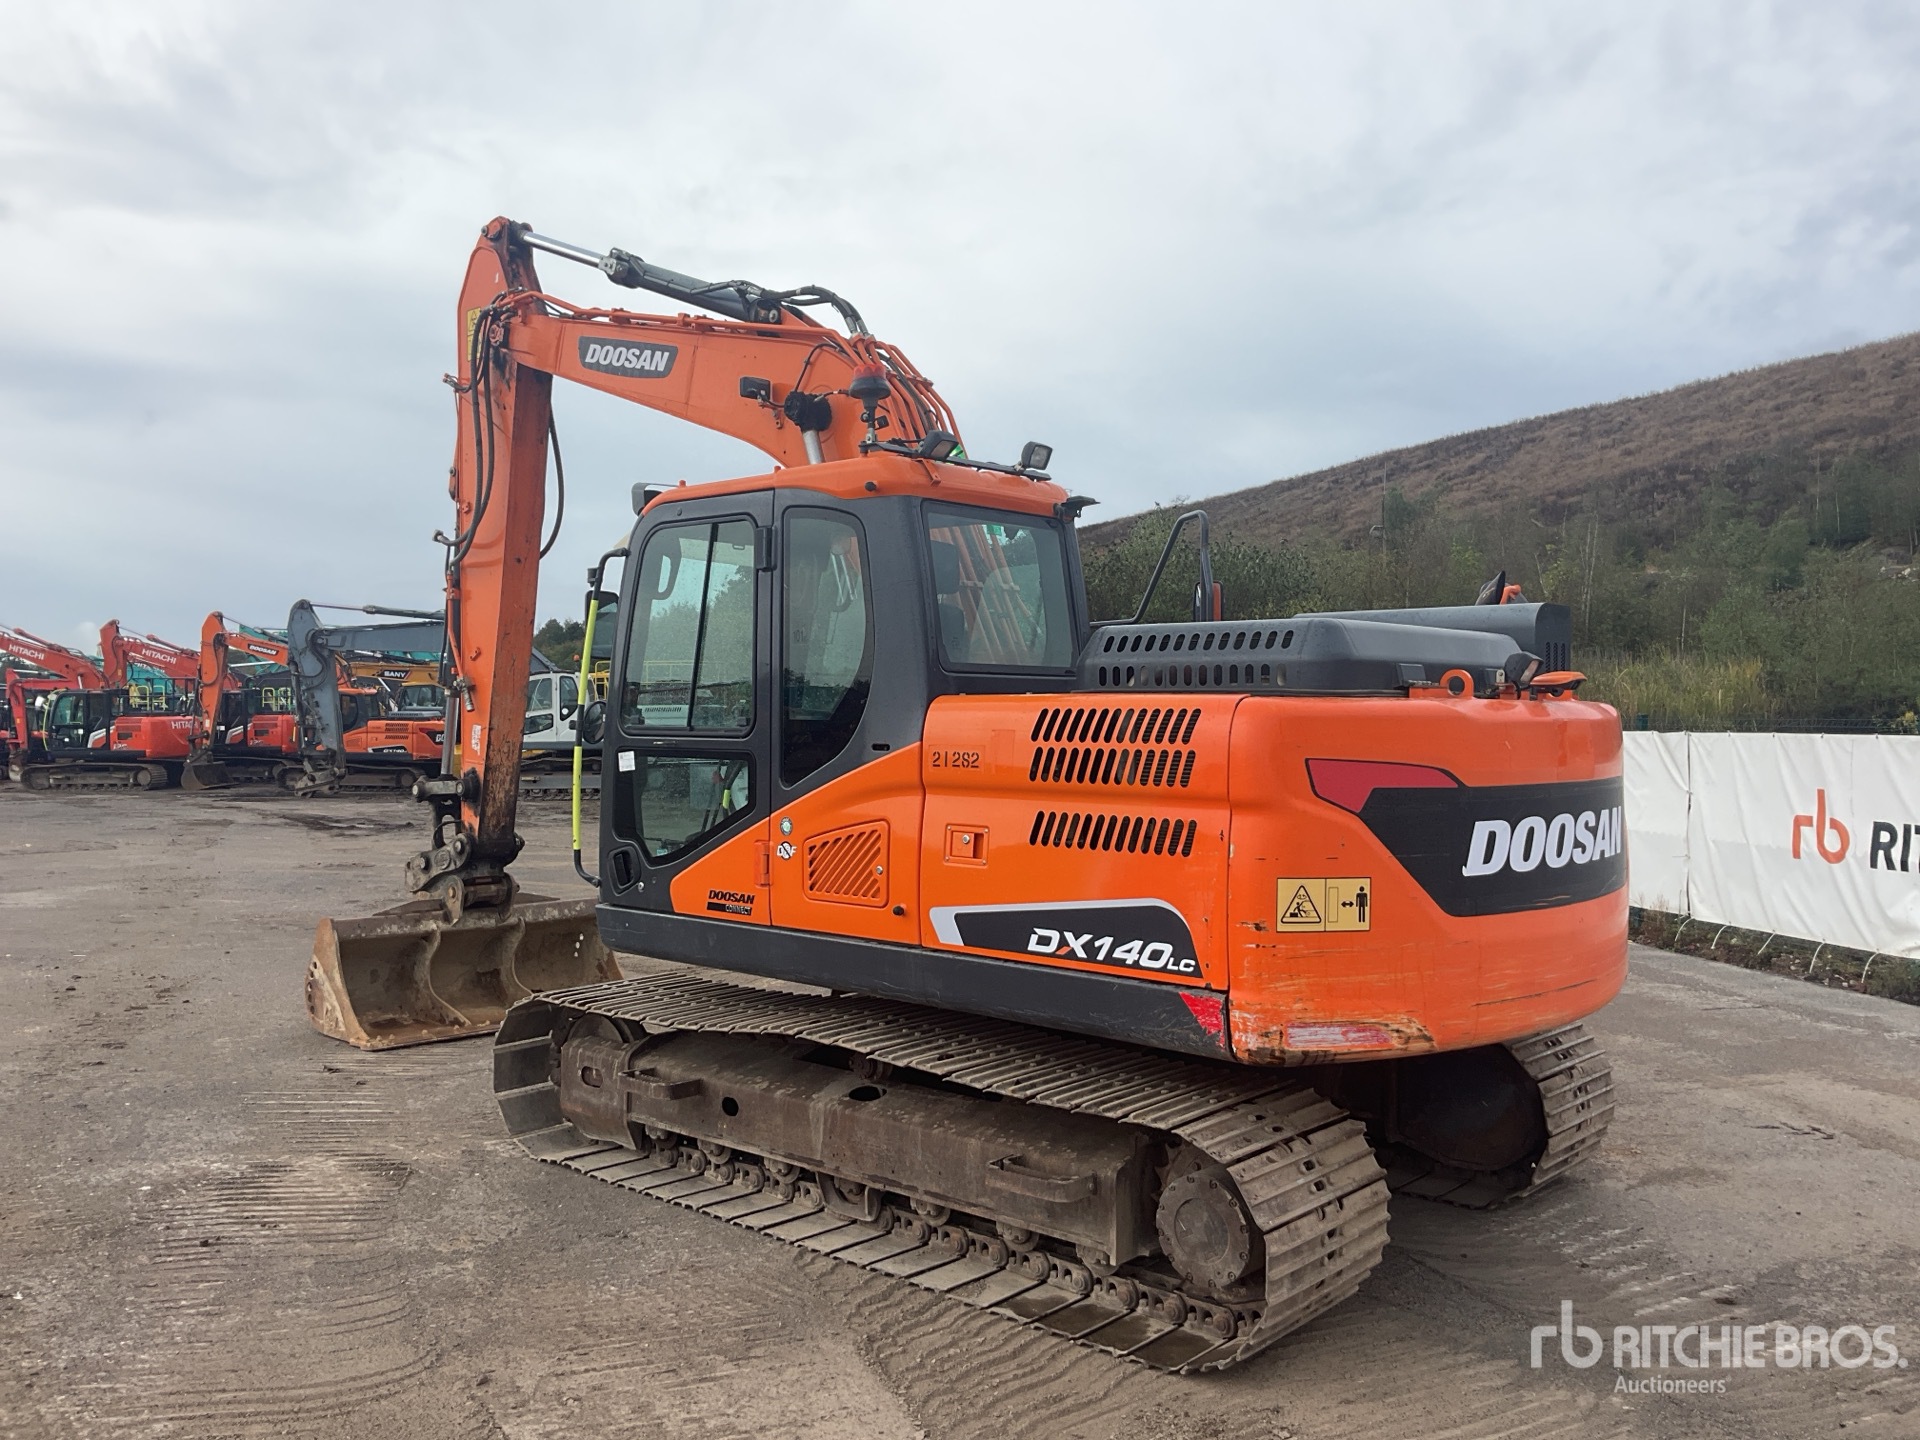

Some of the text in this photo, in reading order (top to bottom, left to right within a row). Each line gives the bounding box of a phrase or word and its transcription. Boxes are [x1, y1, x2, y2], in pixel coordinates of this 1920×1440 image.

[585, 343, 670, 372] DOOSAN
[8, 644, 45, 661] HITACHI
[142, 648, 177, 665] HITACHI
[249, 645, 277, 656] DOOSAN
[384, 670, 406, 678] SANY
[932, 751, 980, 768] 21282
[1461, 806, 1622, 877] DOOSAN
[1870, 821, 1920, 873] RI
[708, 889, 755, 904] DOOSAN
[725, 904, 751, 914] CONNECT
